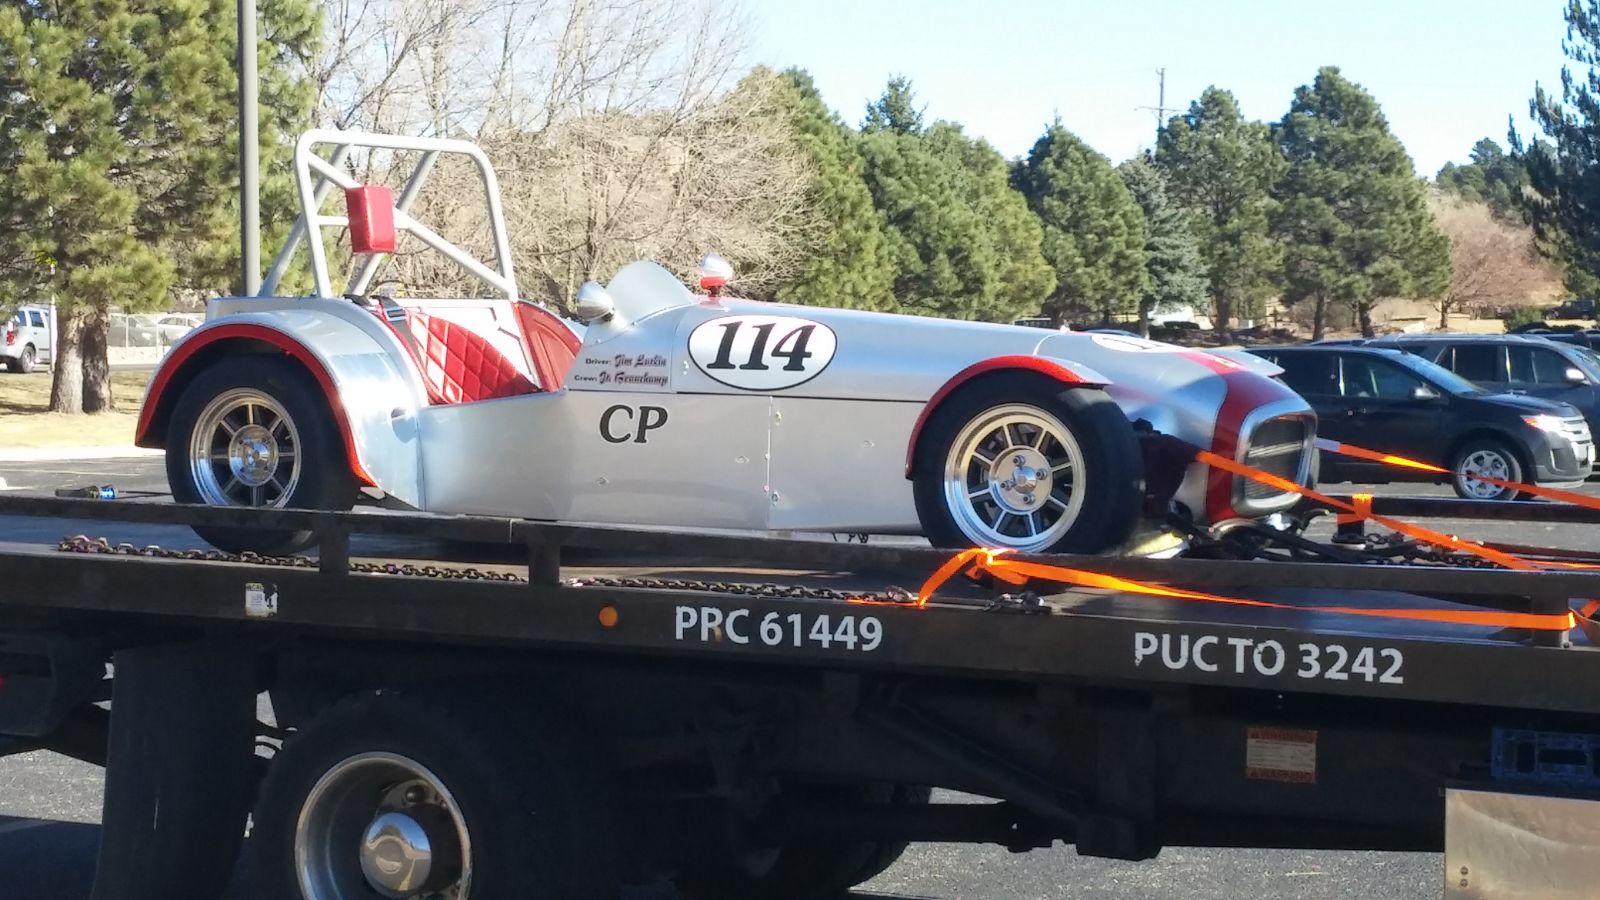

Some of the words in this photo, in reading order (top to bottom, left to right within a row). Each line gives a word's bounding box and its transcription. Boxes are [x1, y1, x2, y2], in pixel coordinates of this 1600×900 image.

[706, 321, 816, 371] 114
[599, 404, 668, 444] CP
[675, 605, 749, 644] PRC
[759, 611, 883, 651] 61449
[1134, 632, 1218, 672] PUC
[1227, 637, 1285, 676] TO
[1297, 643, 1404, 684] 3242
